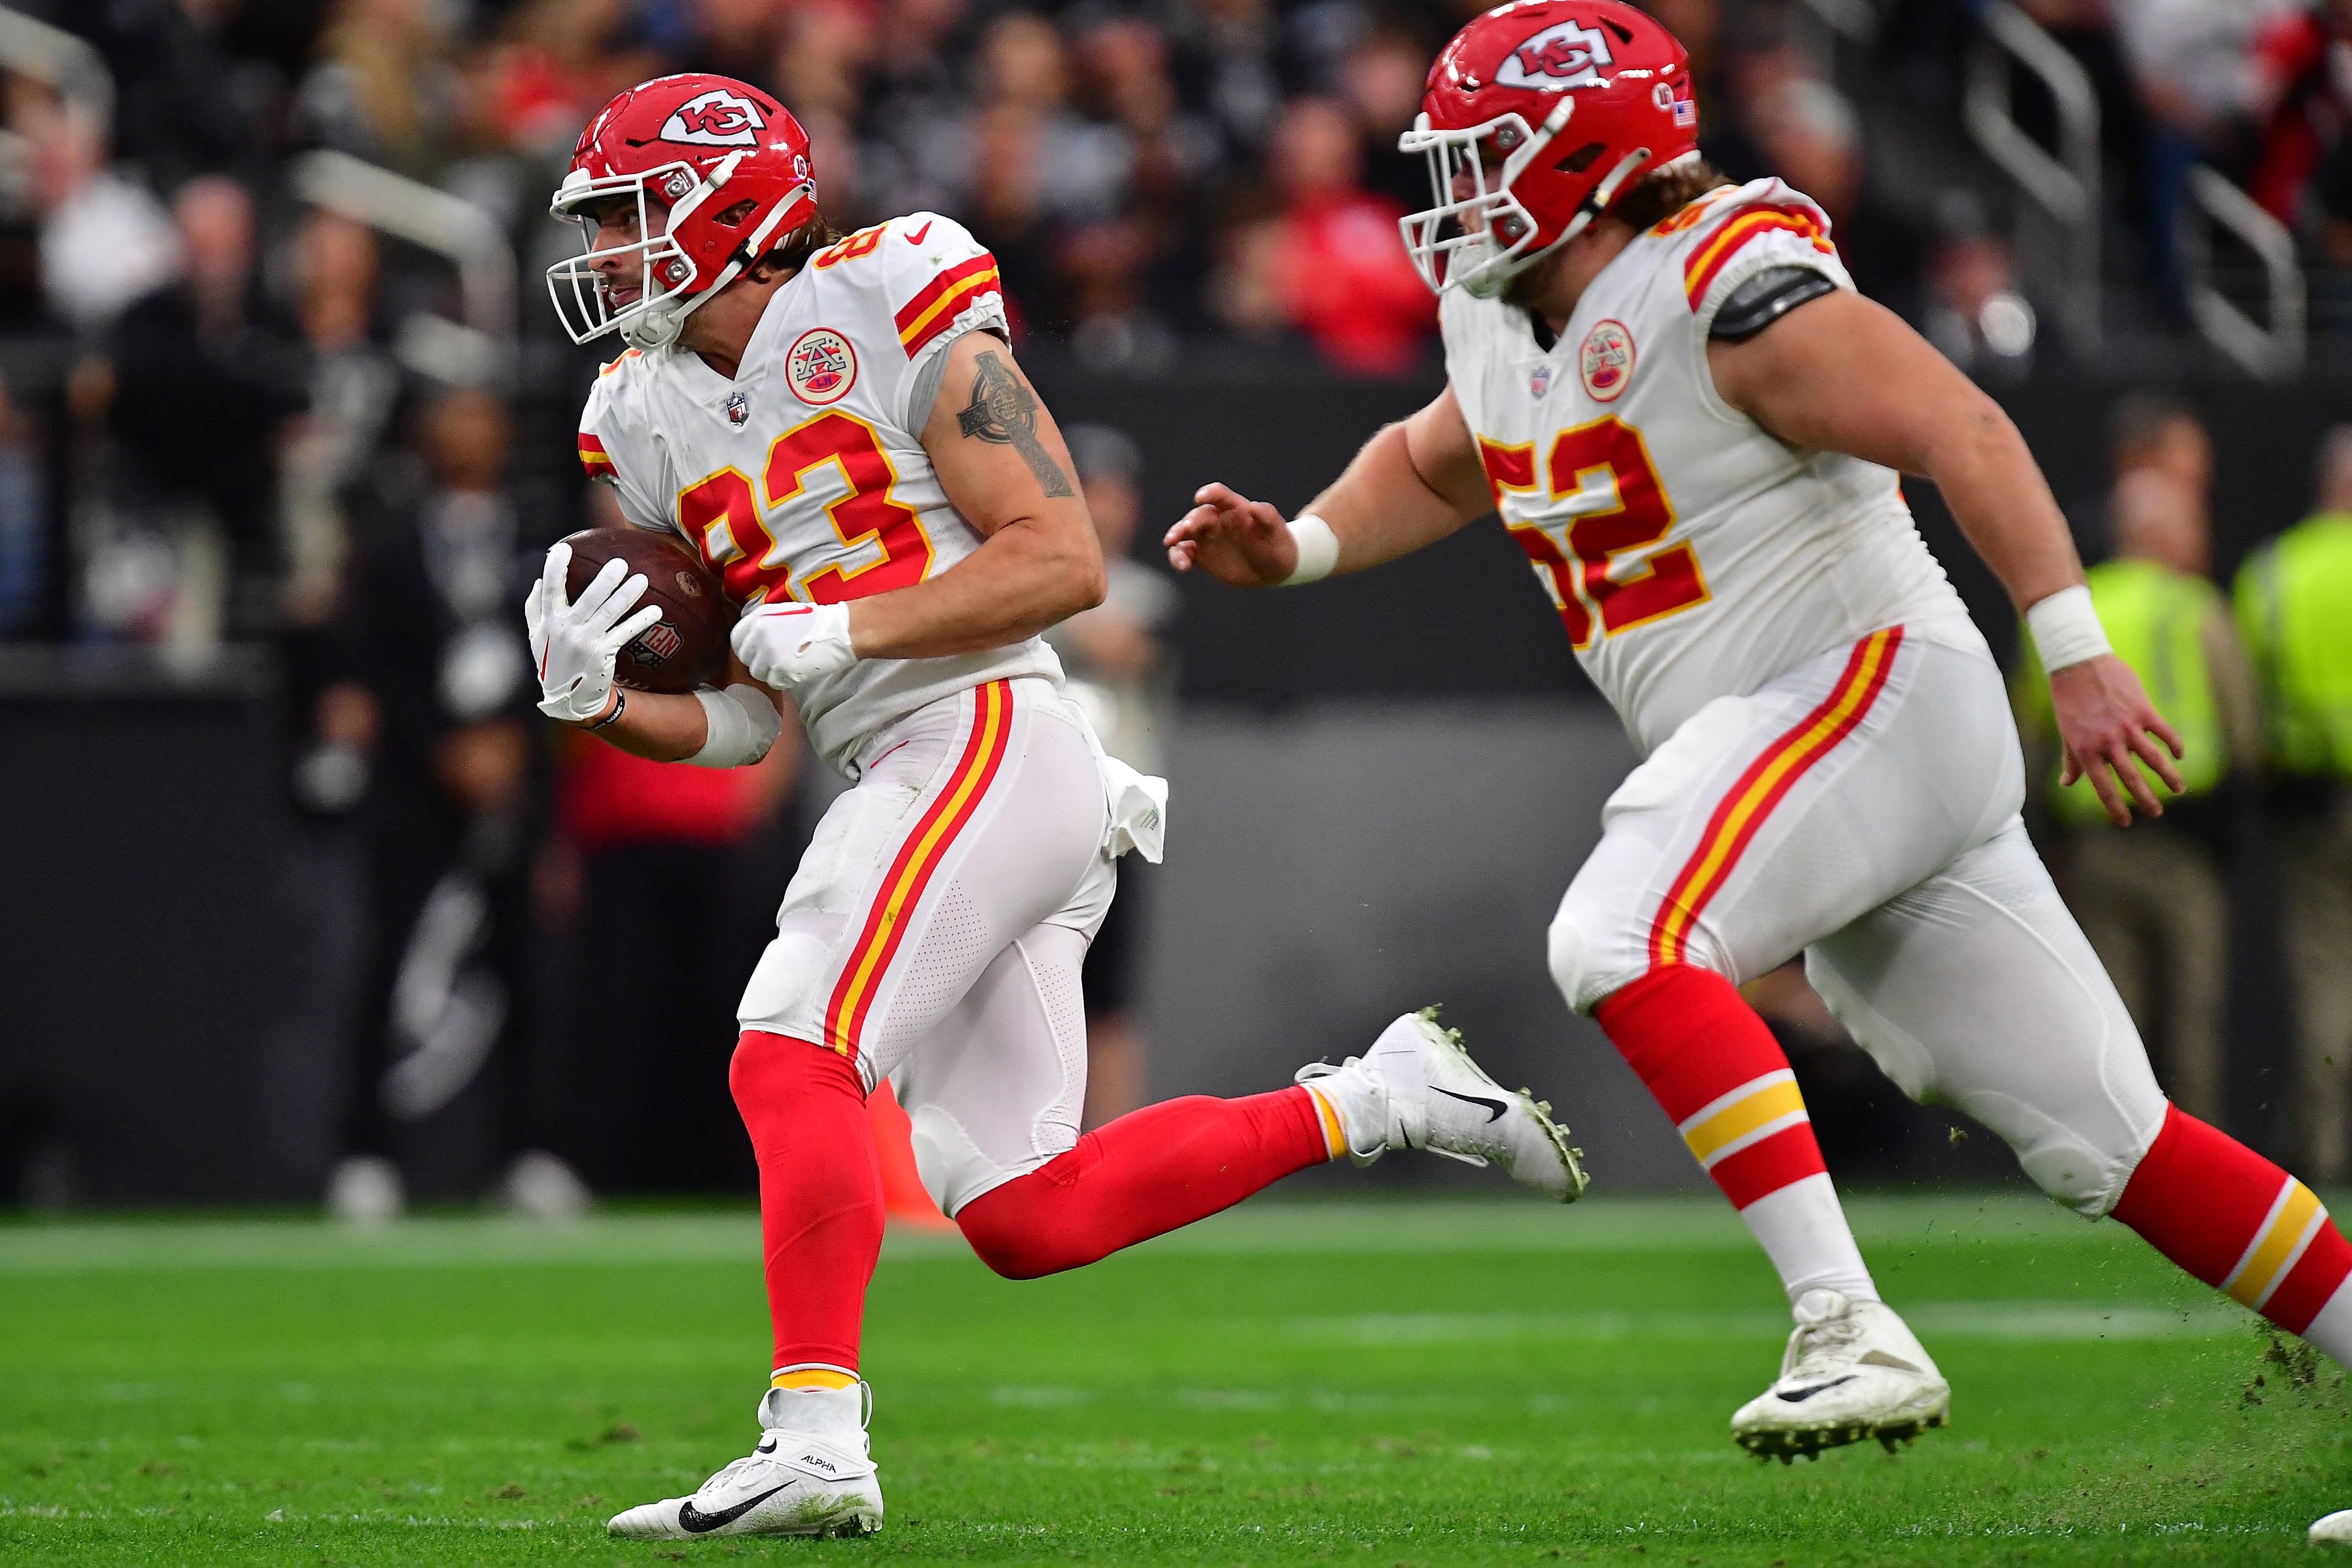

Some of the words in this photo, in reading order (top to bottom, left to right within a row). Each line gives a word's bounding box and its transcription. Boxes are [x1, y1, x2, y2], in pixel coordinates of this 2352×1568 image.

[1514, 35, 1595, 78] KC
[676, 100, 752, 136] KC
[796, 338, 847, 382] A
[815, 375, 833, 388] LH
[677, 408, 936, 605] 83
[1477, 412, 1713, 651] 52
[645, 624, 680, 658] NFL
[801, 1455, 836, 1474] ALPHA
